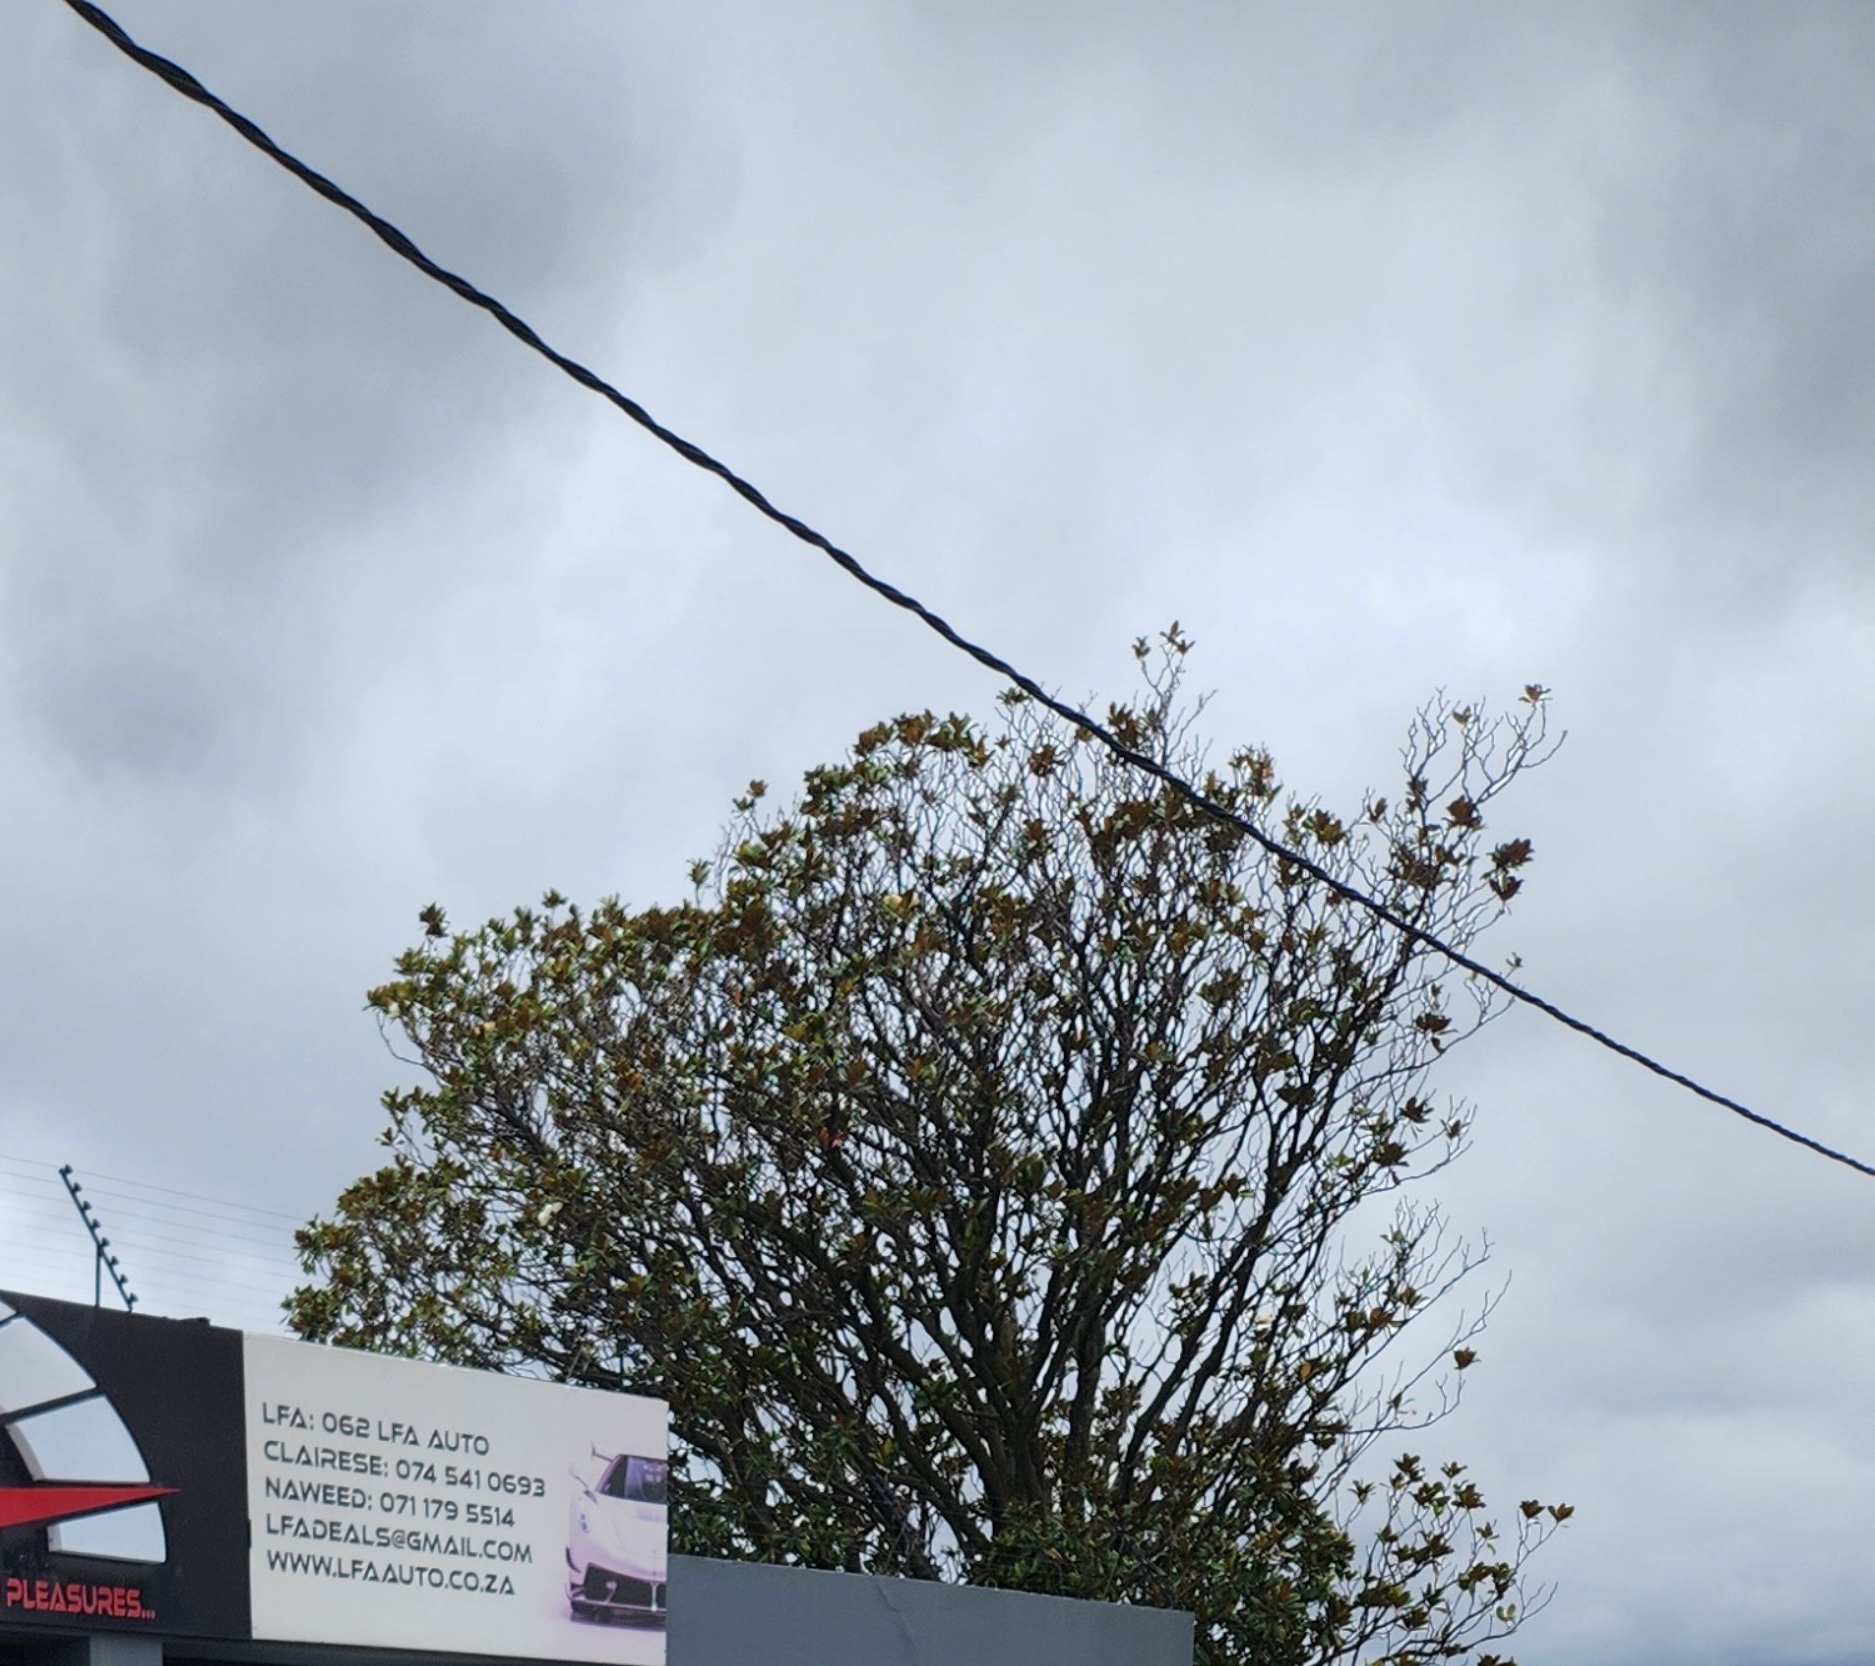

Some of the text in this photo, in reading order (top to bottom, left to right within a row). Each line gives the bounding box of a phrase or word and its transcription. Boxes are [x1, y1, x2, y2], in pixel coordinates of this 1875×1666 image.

[262, 1402, 490, 1456] LFA: 062 LFA AUTO
[264, 1441, 545, 1497] CLAIRESE: 074 541 0693
[265, 1477, 515, 1528] NAWEED: 071 179 5514
[266, 1514, 533, 1564] LFADEALS@GMAIL.COM
[268, 1550, 515, 1596] WWW.LFAAUTO.CO.ZA
[6, 1577, 156, 1620] PLEASURES...
